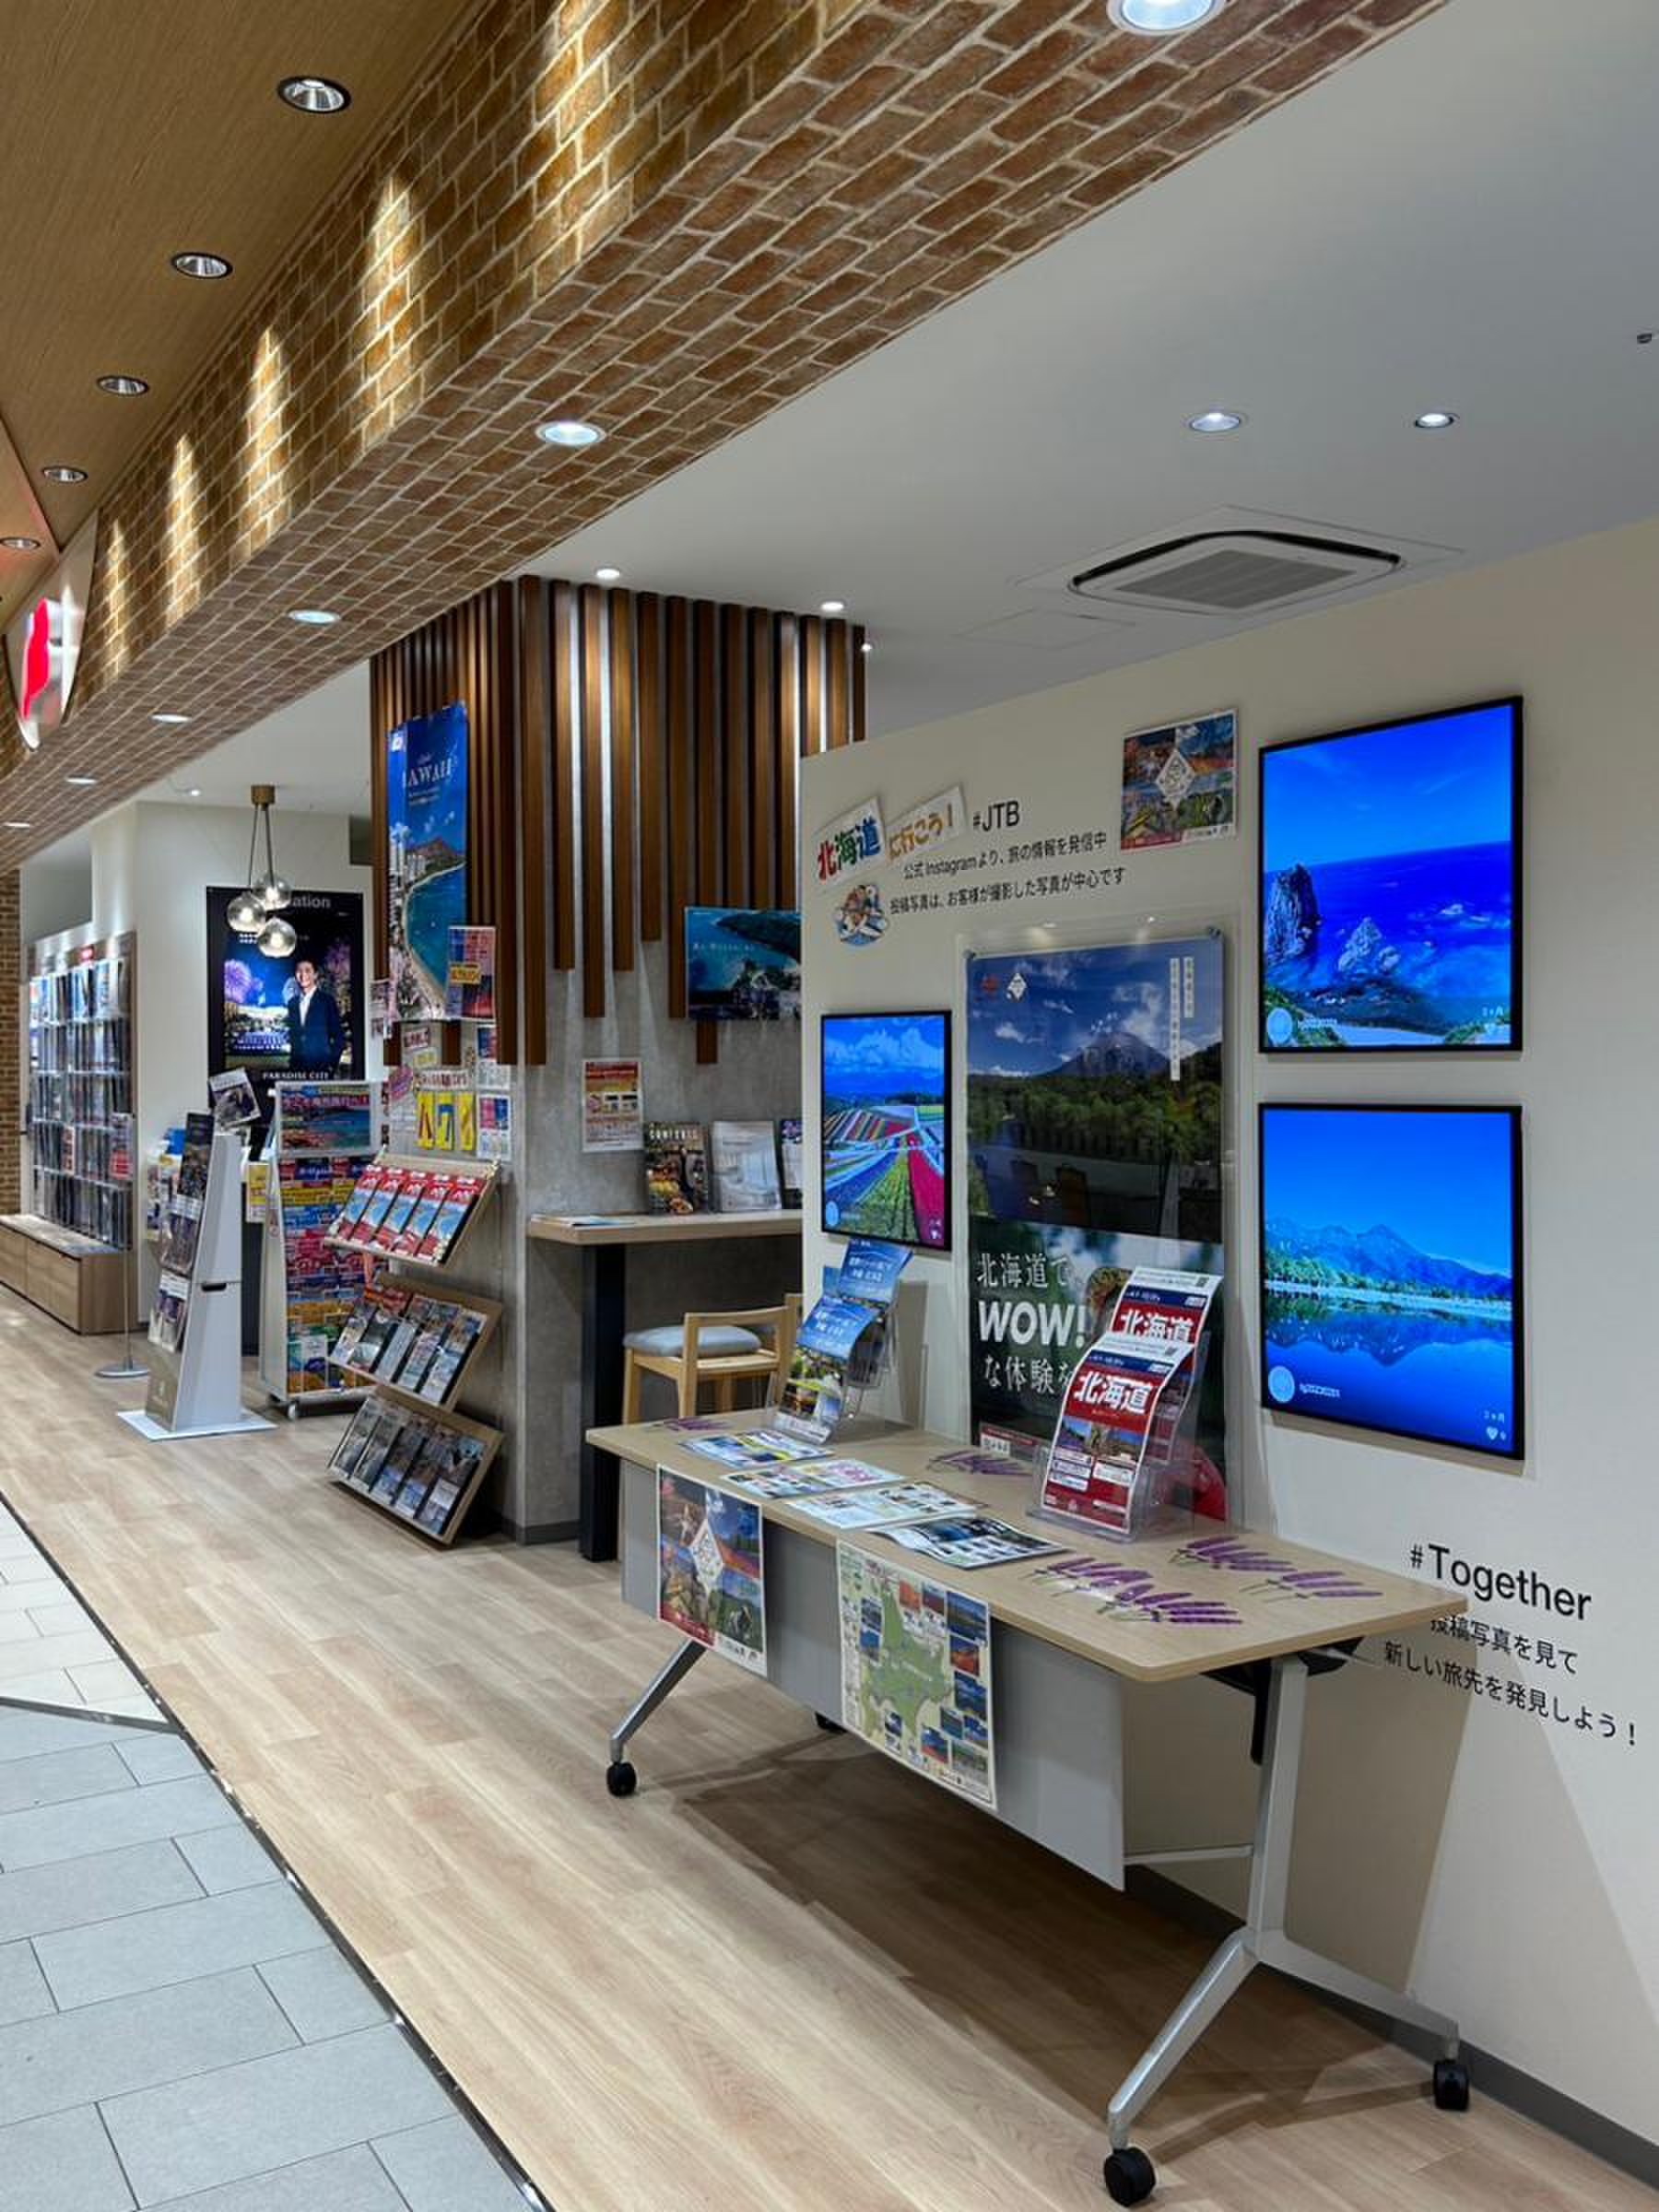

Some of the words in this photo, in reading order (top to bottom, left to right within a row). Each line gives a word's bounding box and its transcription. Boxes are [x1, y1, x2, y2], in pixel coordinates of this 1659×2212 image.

[972, 800, 1020, 831] #JTB
[817, 815, 881, 881] 北海道
[978, 1300, 1086, 1348] WOW!
[1120, 1307, 1195, 1343] 北海道
[1073, 1371, 1152, 1415] 北海道
[1410, 1543, 1592, 1620] #Together
[1384, 1640, 1635, 1746] 新しい旅先を発見しよう！
